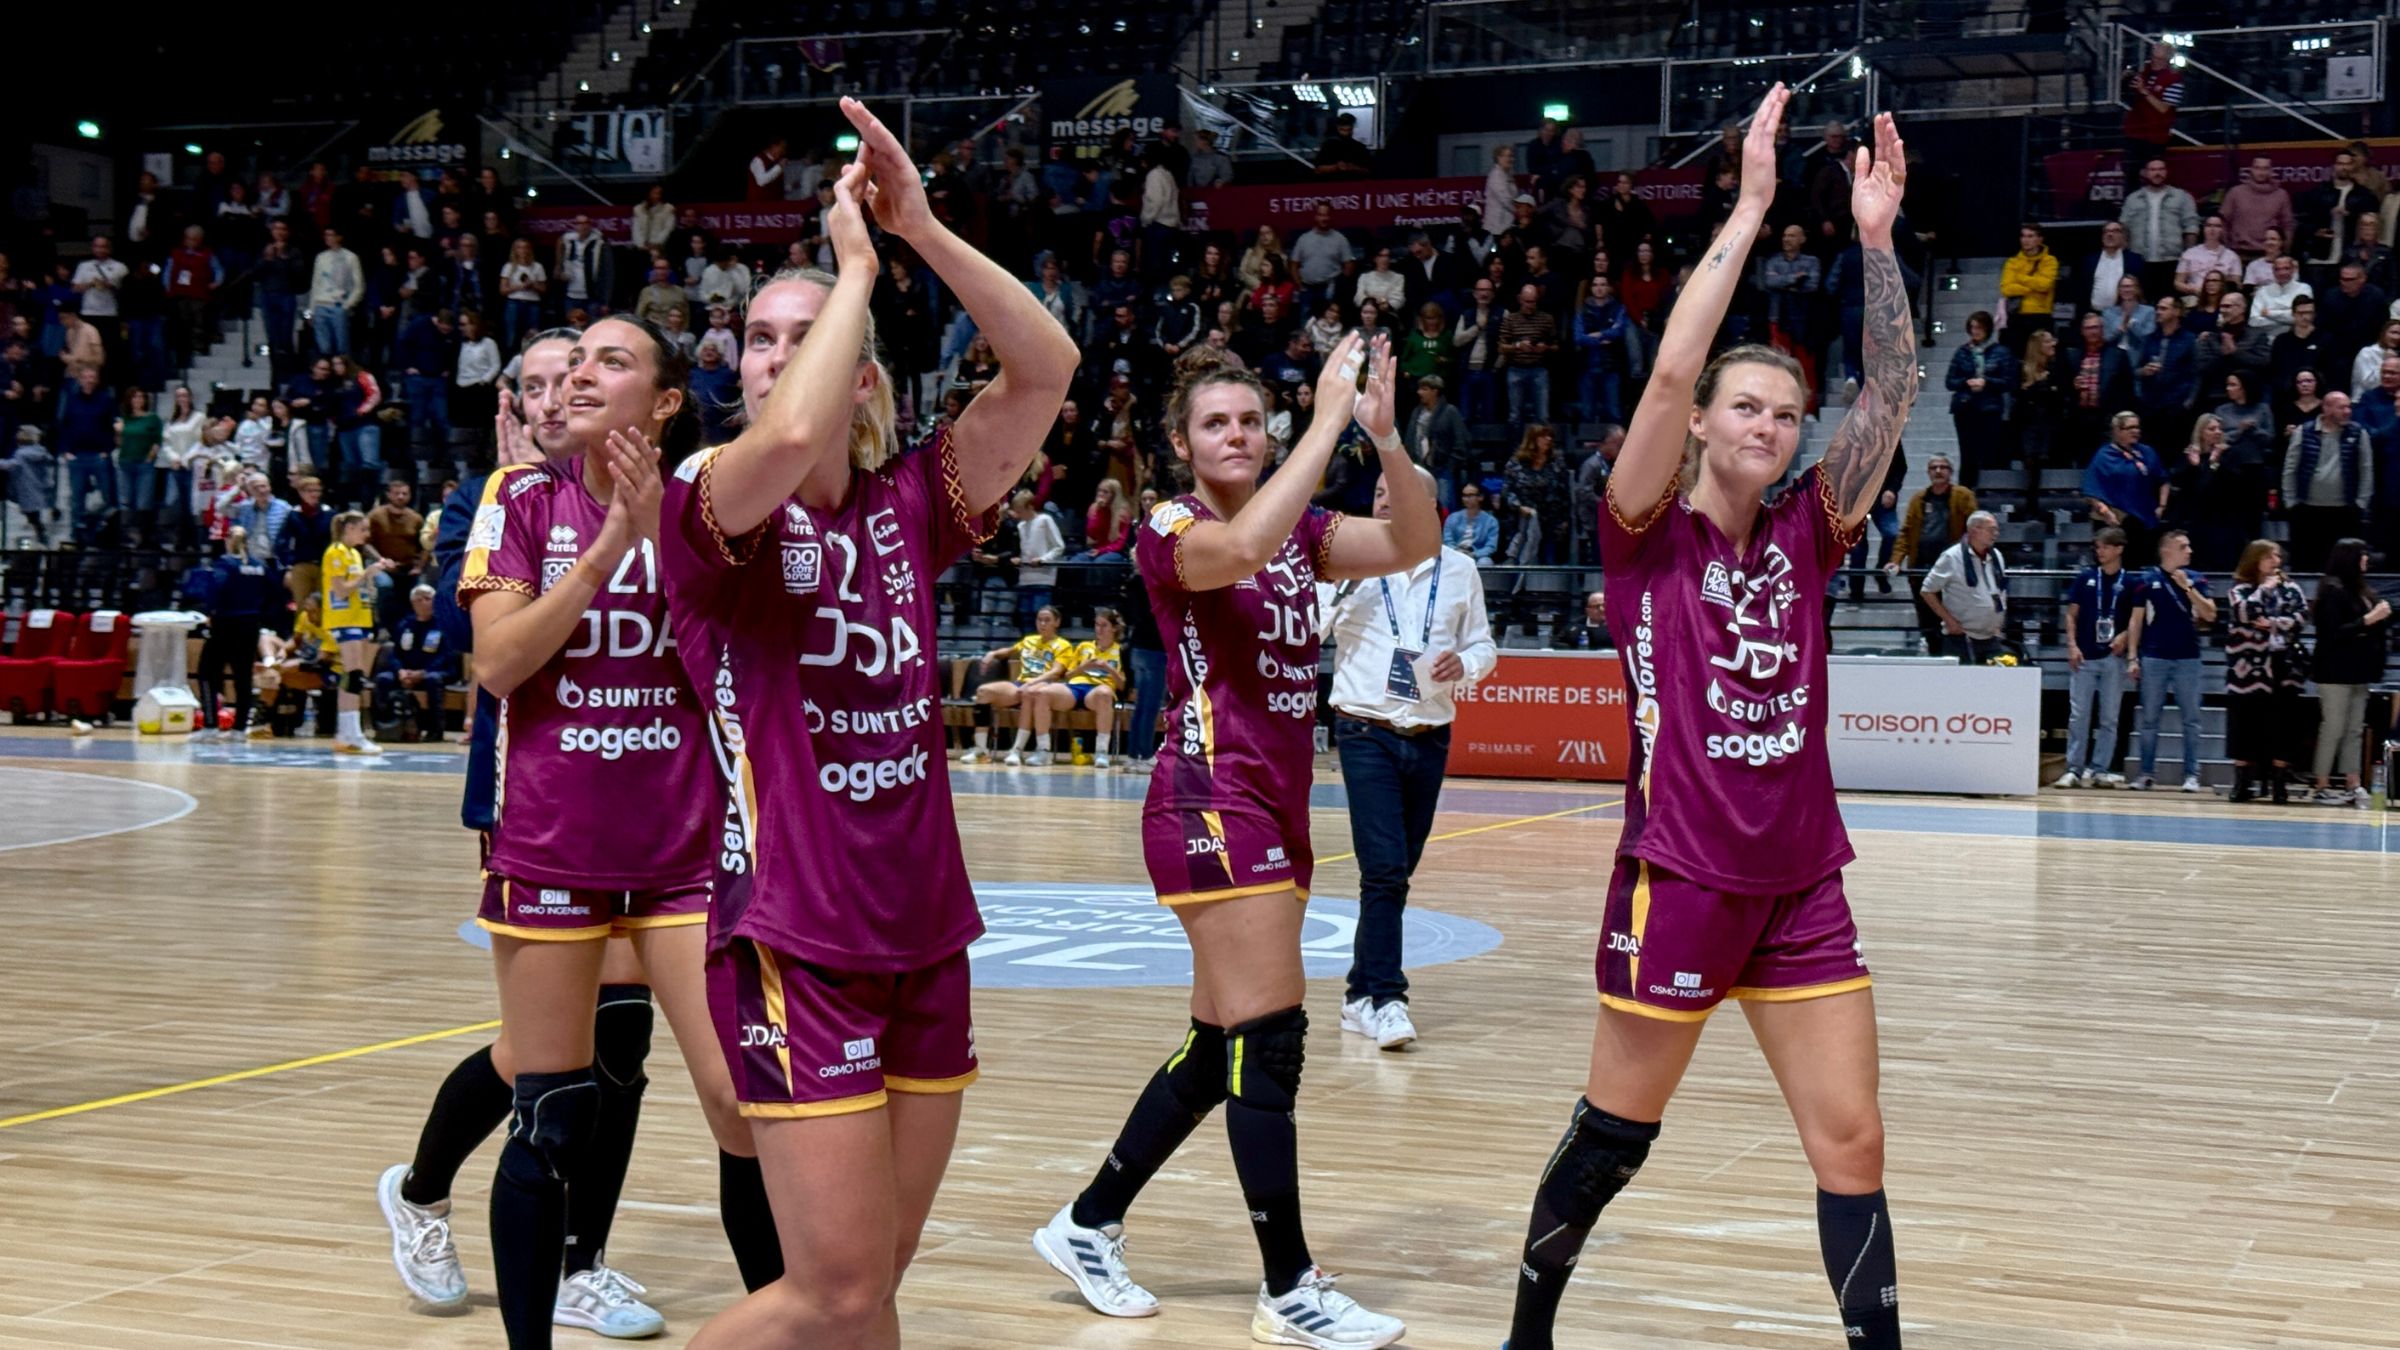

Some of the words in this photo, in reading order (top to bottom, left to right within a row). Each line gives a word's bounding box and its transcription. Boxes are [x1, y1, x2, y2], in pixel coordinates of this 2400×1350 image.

[1051, 116, 1165, 138] message
[367, 143, 467, 163] message
[1376, 193, 1411, 209] UNE
[1413, 188, 1460, 207] MÊME
[607, 537, 657, 594] 21
[781, 549, 816, 566] 100
[588, 687, 678, 708] SUNTEC
[1483, 685, 1560, 704] CENTRE
[1565, 687, 1591, 704] DE
[1596, 687, 1627, 705] SH
[831, 699, 932, 735] SUNTEC
[560, 717, 681, 761] sogedo
[1707, 721, 1806, 767] soged
[1468, 741, 1536, 755] PRIMARK
[1557, 739, 1608, 765] ZARA
[1186, 837, 1225, 855] JDA
[518, 904, 546, 915] OSMO
[1607, 932, 1639, 955] JDA
[1650, 984, 1678, 997] OSMO
[740, 1025, 786, 1047] JDA
[819, 1062, 855, 1078] OSMO
